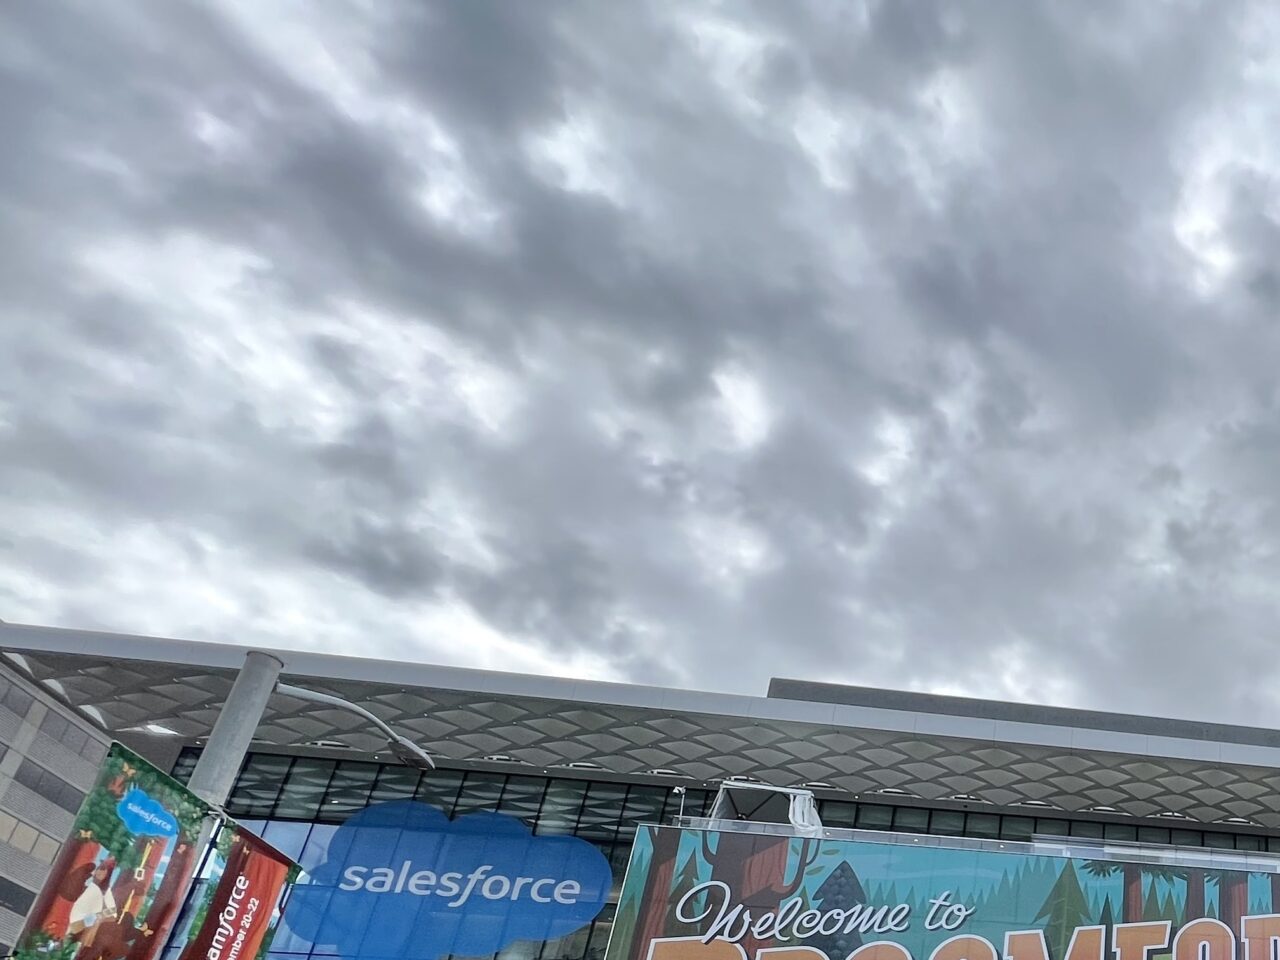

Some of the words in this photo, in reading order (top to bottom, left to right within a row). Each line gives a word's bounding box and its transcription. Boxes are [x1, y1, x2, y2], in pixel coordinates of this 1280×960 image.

[338, 860, 581, 907] salesforce
[675, 880, 912, 944] Welcome
[924, 890, 977, 930] to
